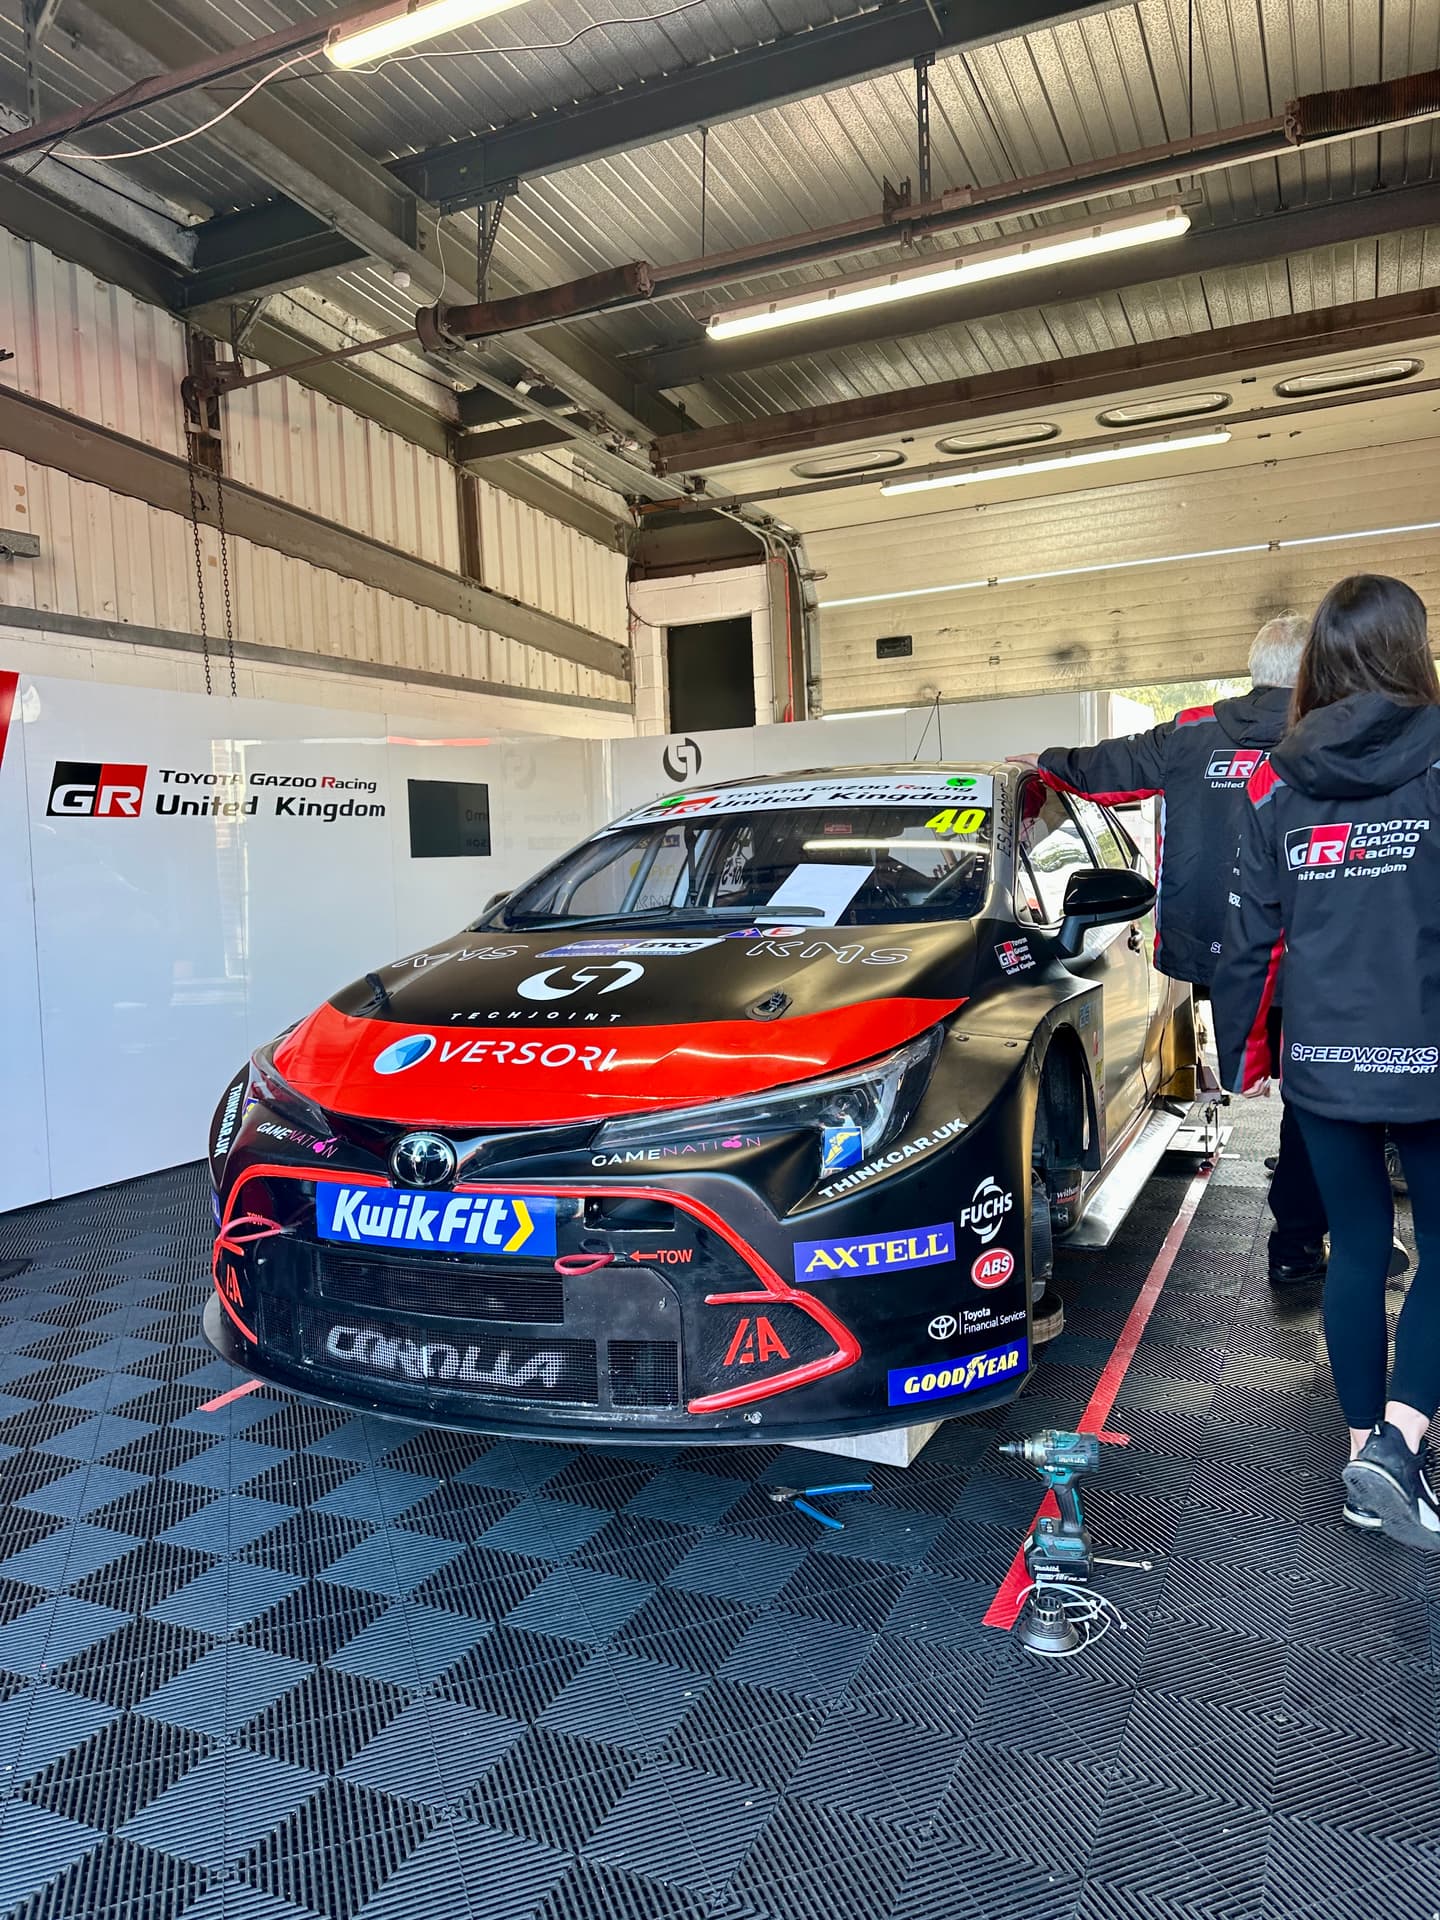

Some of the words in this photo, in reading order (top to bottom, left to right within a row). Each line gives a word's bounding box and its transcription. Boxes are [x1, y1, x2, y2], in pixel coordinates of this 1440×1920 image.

[1207, 761, 1254, 776] GR
[159, 769, 244, 786] TOYOTA
[249, 772, 317, 789] GAZOO
[321, 776, 378, 793] Racing
[727, 787, 805, 799] TOYOTA
[895, 783, 974, 793] Racing
[1210, 780, 1245, 789] United
[51, 783, 141, 816] GR
[156, 794, 257, 818] United
[275, 796, 386, 822] Kingdom
[709, 793, 815, 810] United
[829, 791, 979, 801] Kingdom
[924, 808, 987, 834] 40
[1354, 820, 1430, 835] TOYOTA
[1350, 832, 1420, 848] GAZOO
[1289, 840, 1344, 866] GR
[1349, 845, 1416, 860] Racing
[1297, 869, 1336, 881] nited
[1344, 863, 1408, 878] Kingdom
[745, 940, 913, 965] KMS
[450, 1011, 622, 1023] TECHJOINT
[1291, 1043, 1439, 1065] SPEEDWORKS
[1353, 1063, 1438, 1074] MOTORSPORT
[213, 1081, 245, 1158] THINKCAR.UK
[818, 1117, 969, 1199] THINKCAR.UK
[960, 1192, 1013, 1228] FUCHS
[657, 1249, 693, 1264] TOW
[804, 1234, 949, 1273] AXTELL
[980, 1255, 1011, 1279] ABS
[963, 1307, 991, 1321] Toyota
[963, 1316, 999, 1334] Financial
[1000, 1310, 1027, 1326] Services
[904, 1350, 1019, 1394] GOODYEAR
